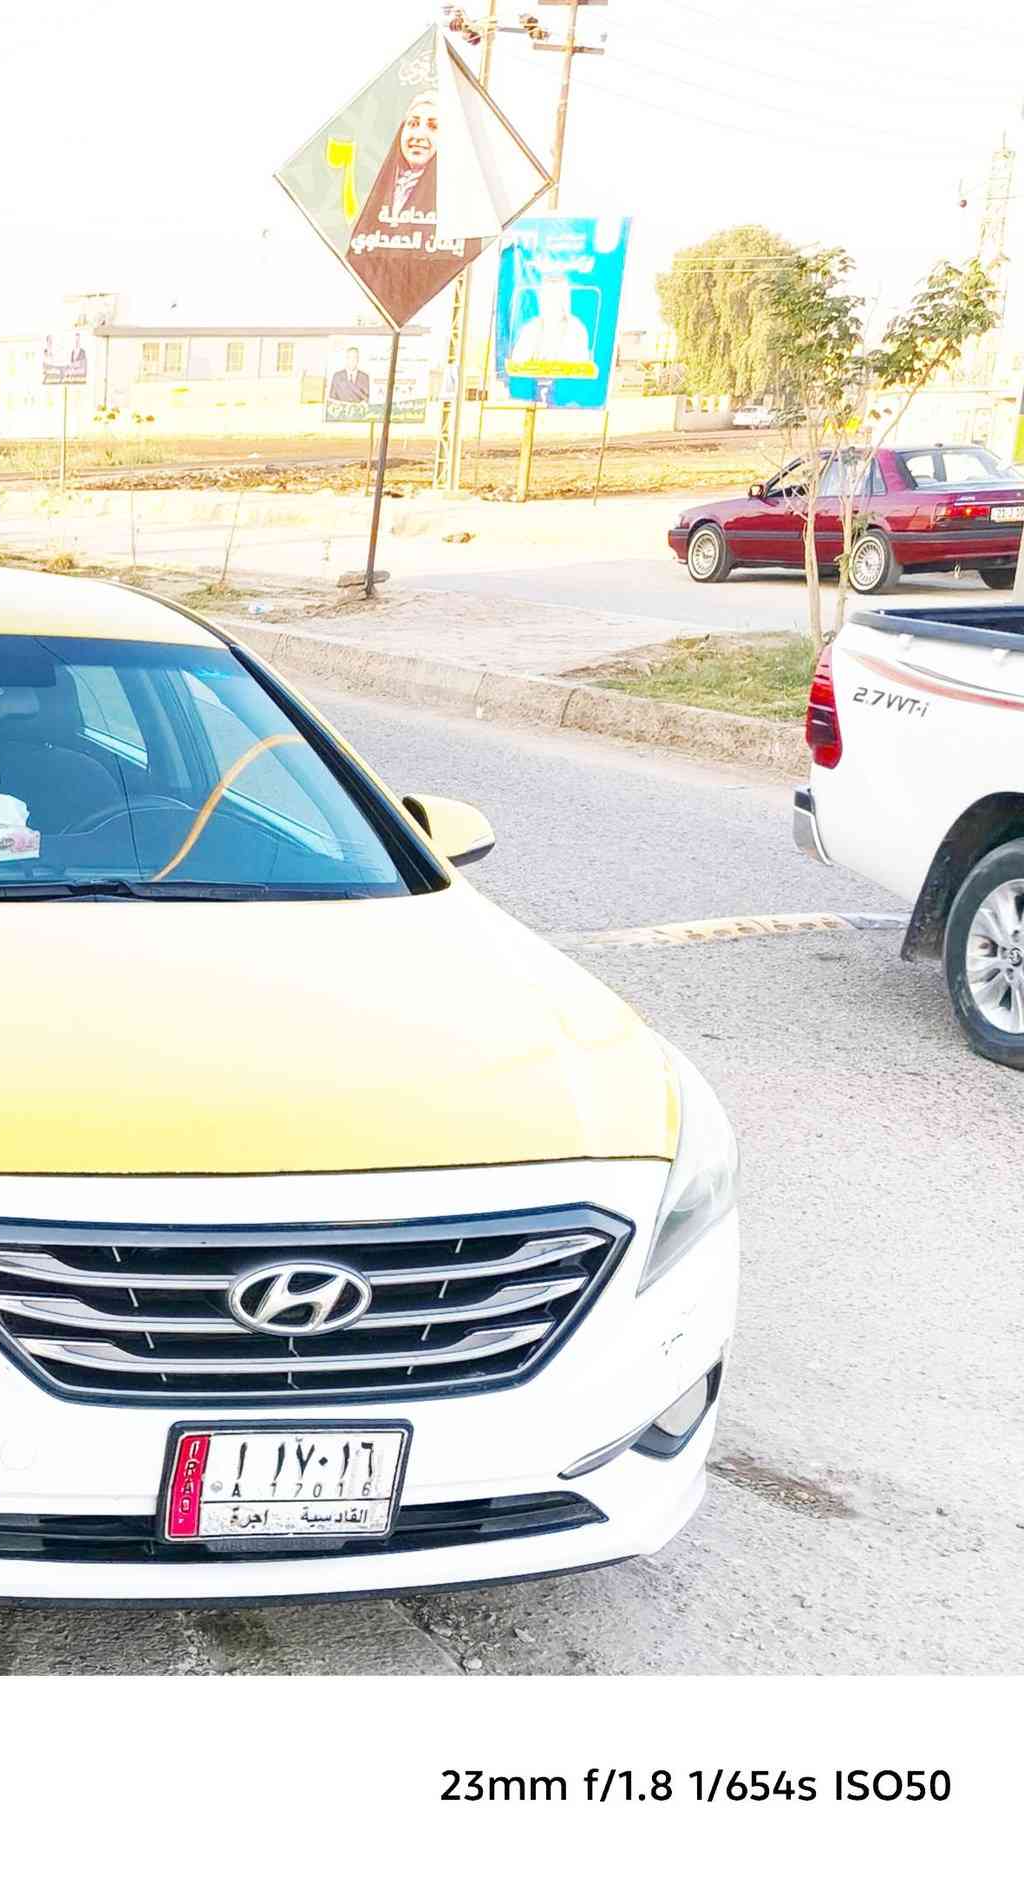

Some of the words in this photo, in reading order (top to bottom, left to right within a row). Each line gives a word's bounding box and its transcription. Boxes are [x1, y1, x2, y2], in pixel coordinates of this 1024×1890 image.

[853, 686, 885, 706] 2.7
[885, 693, 930, 718] VVT-i
[231, 1482, 242, 1498] A
[300, 1507, 369, 1529] القادسية
